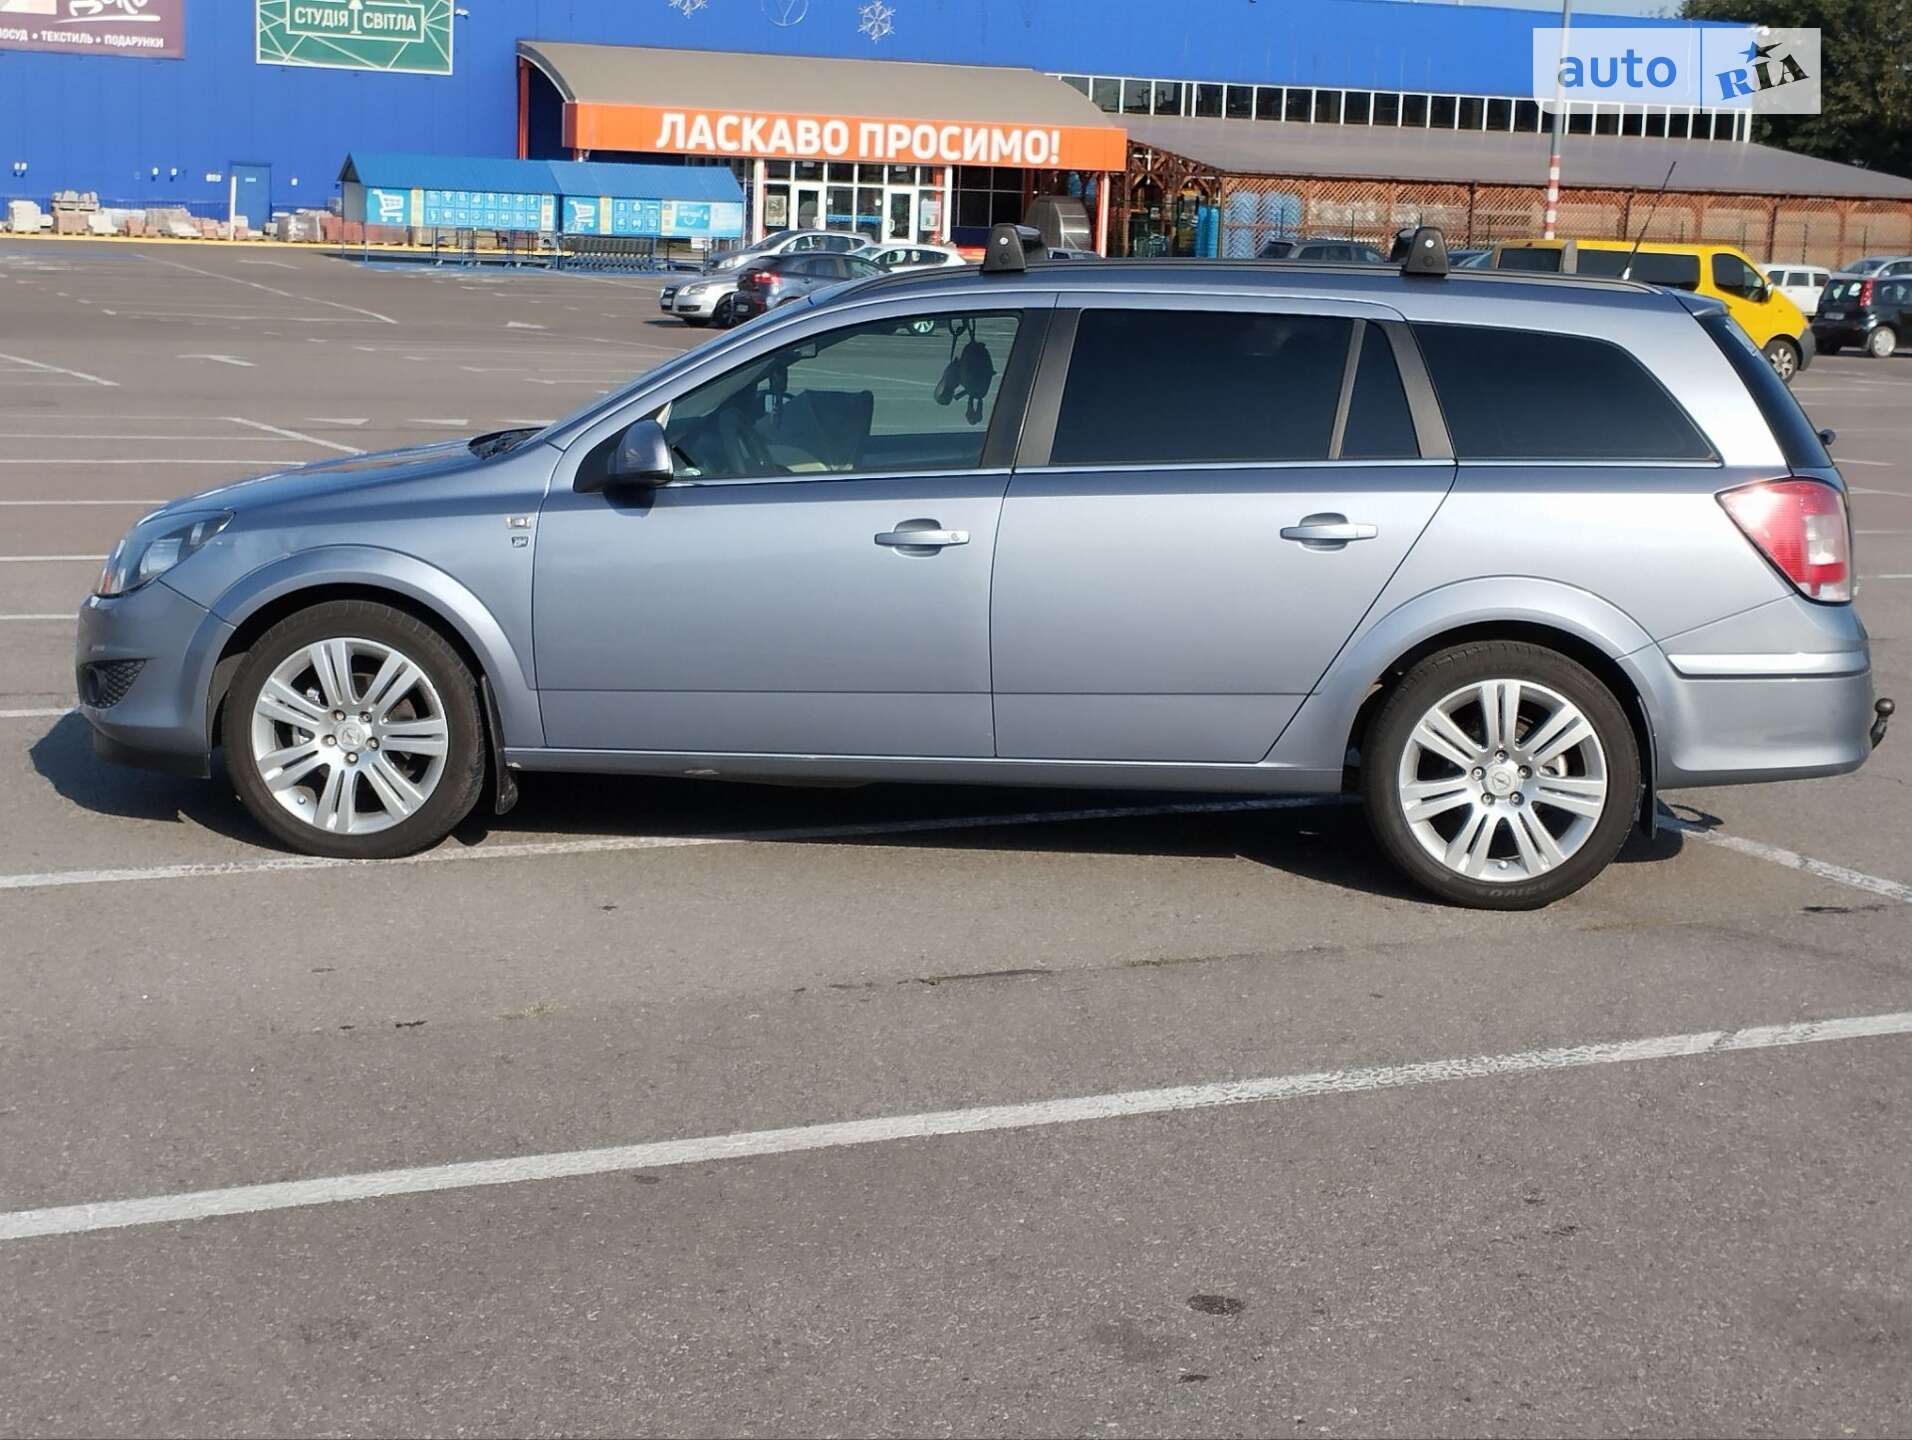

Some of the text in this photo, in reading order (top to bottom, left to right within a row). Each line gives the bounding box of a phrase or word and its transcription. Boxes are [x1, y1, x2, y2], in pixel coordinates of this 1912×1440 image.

[294, 6, 417, 31] СТУДІЯ СВІТЛА
[40, 30, 93, 45] ТЕКСТИЛЬ
[104, 34, 165, 48] ПОДАРУНКИ
[655, 111, 1062, 165] ЛАСКАВО ПРОСИМО!
